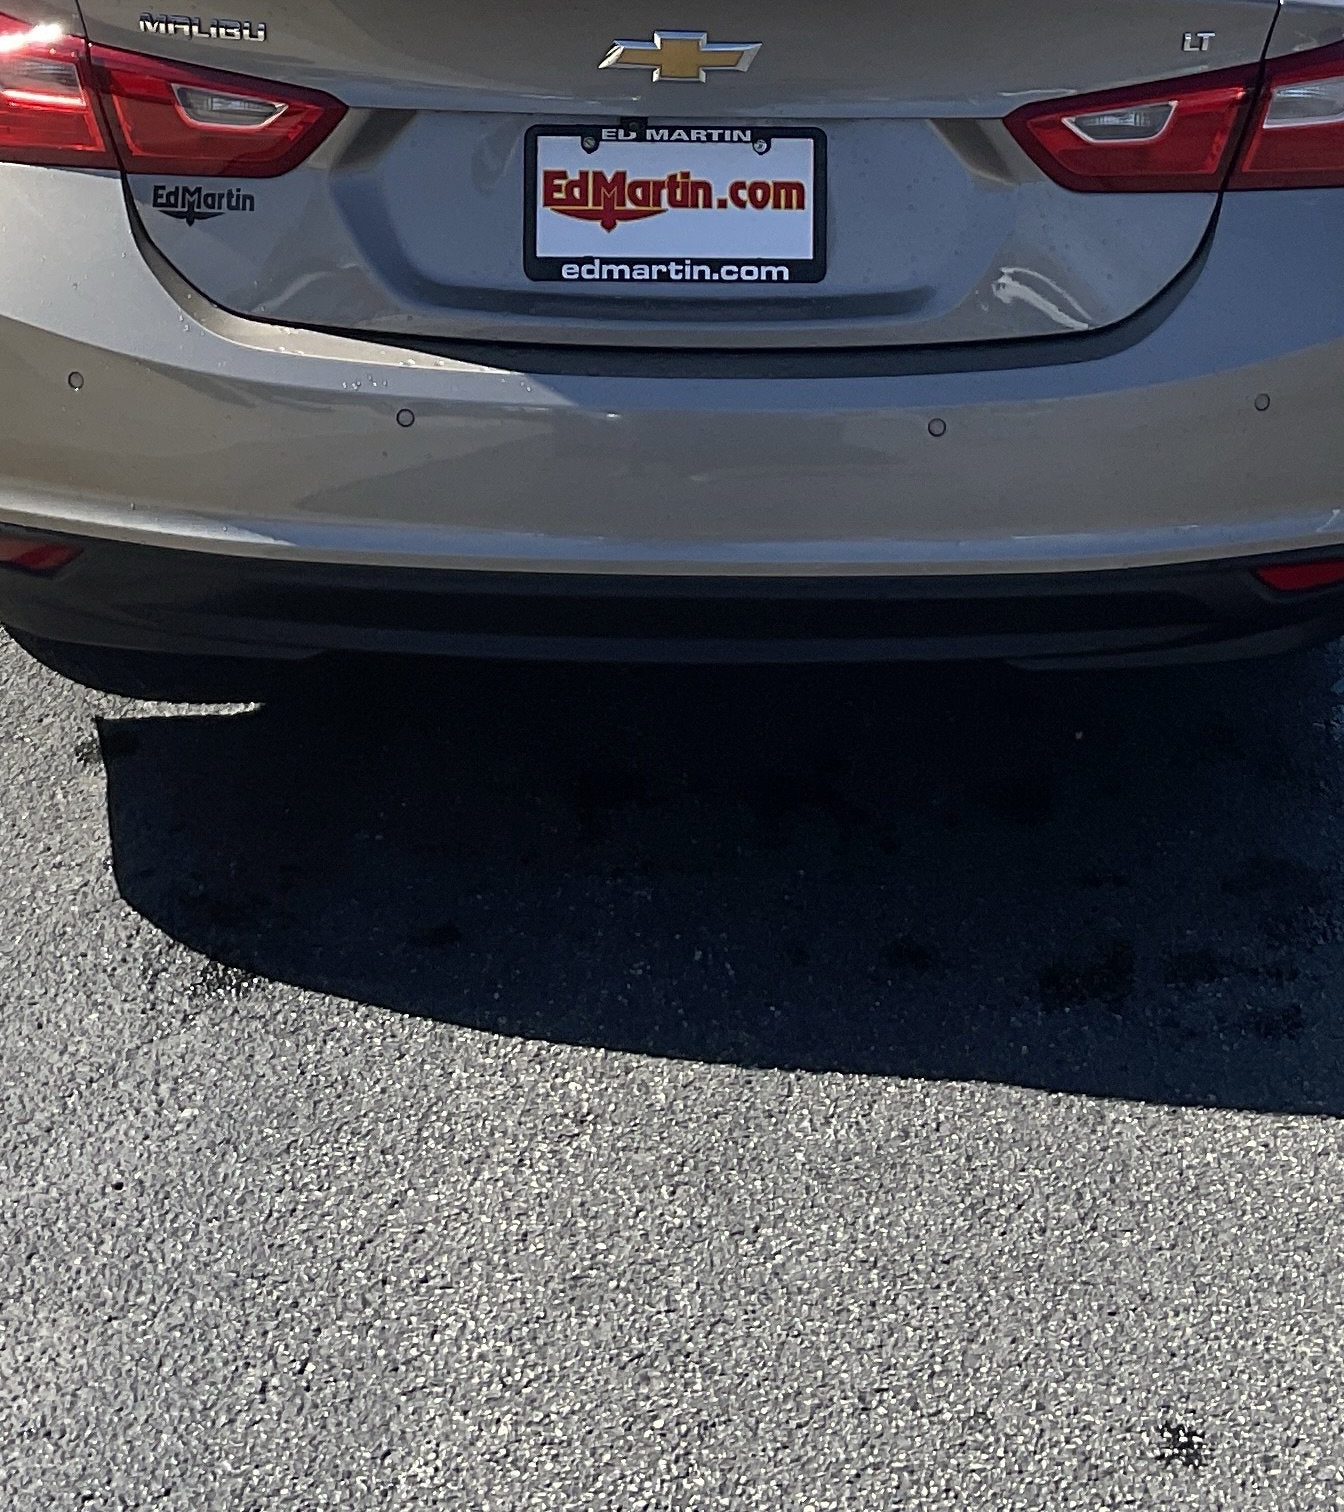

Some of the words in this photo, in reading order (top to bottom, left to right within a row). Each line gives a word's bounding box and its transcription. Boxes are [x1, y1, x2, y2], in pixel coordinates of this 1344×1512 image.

[139, 12, 267, 42] MALIBU
[1182, 31, 1216, 51] LT
[601, 128, 637, 140] ED
[646, 129, 752, 142] MARTIN
[152, 185, 255, 215] EdMartin
[542, 169, 806, 216] EdMartin.com
[561, 259, 789, 282] edmartin.com
